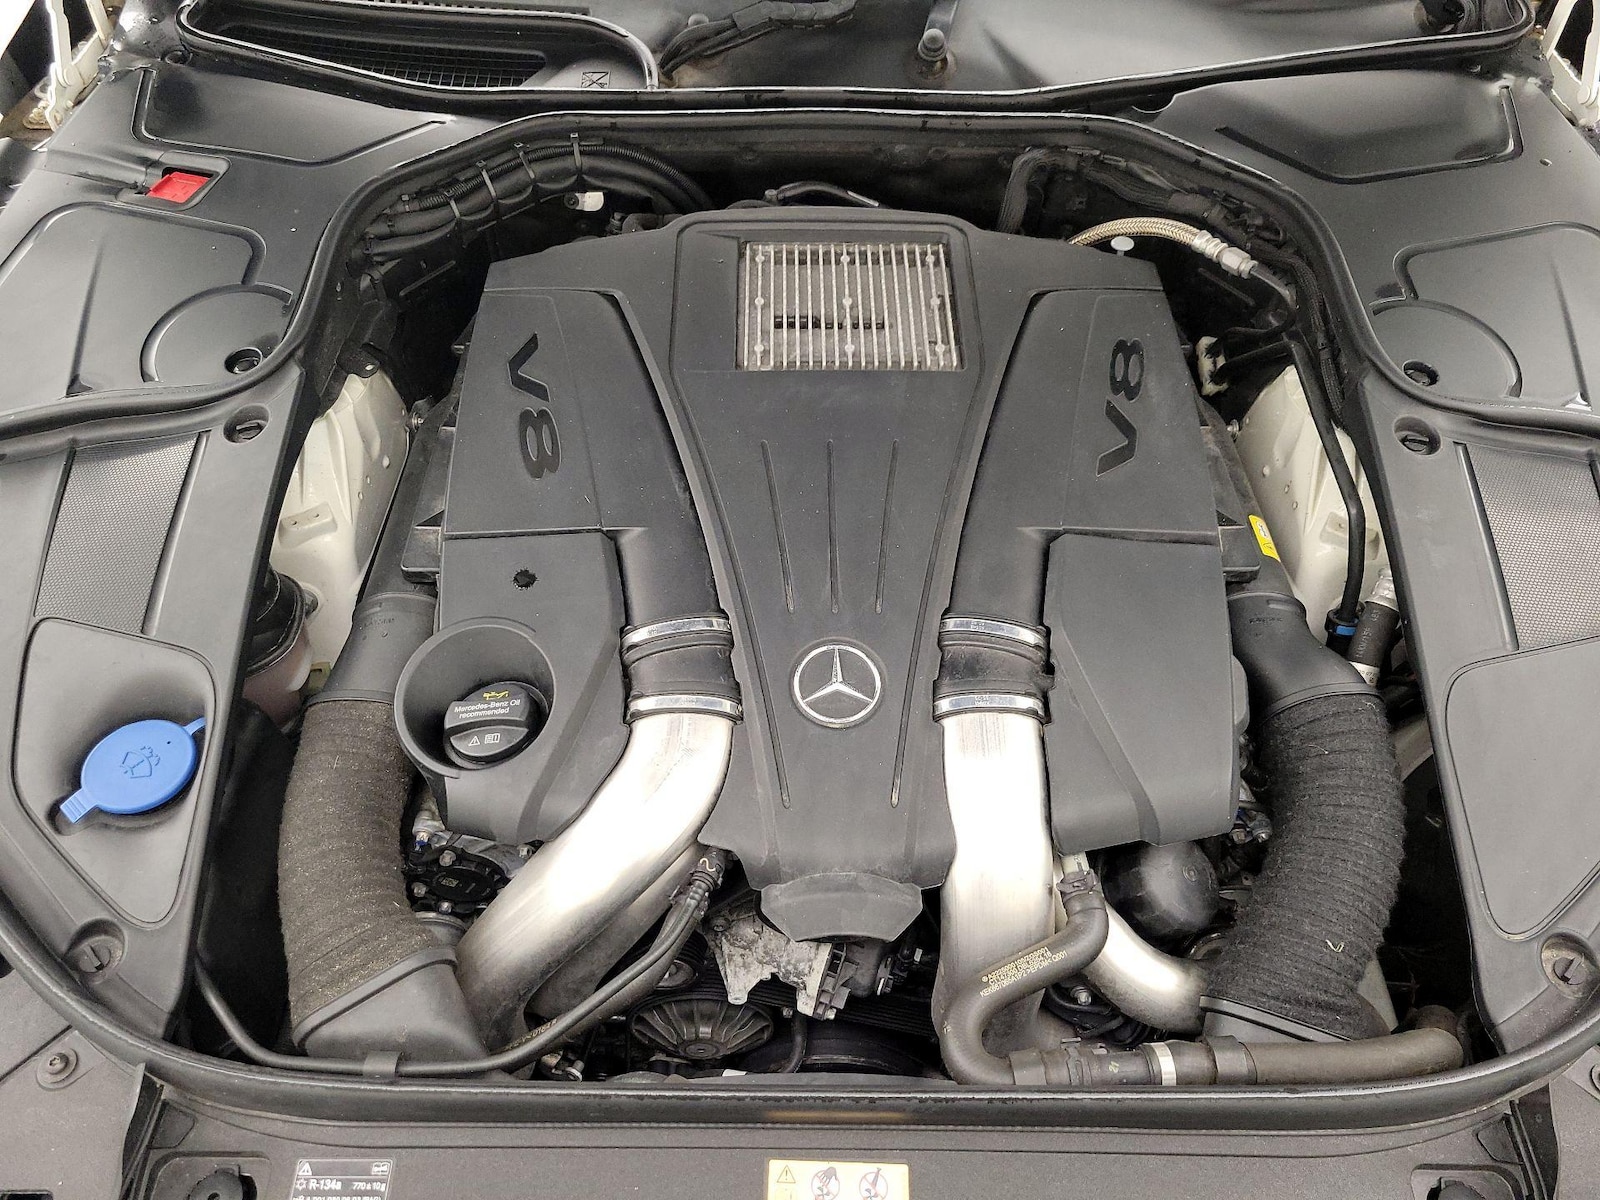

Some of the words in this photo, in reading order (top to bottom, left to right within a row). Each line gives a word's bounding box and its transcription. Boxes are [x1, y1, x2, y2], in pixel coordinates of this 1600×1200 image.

[507, 331, 562, 479] V8
[1096, 337, 1145, 477] V8
[454, 701, 509, 713] Mercedes-Benz
[459, 707, 510, 719] recommended
[309, 1179, 342, 1190] R-134a
